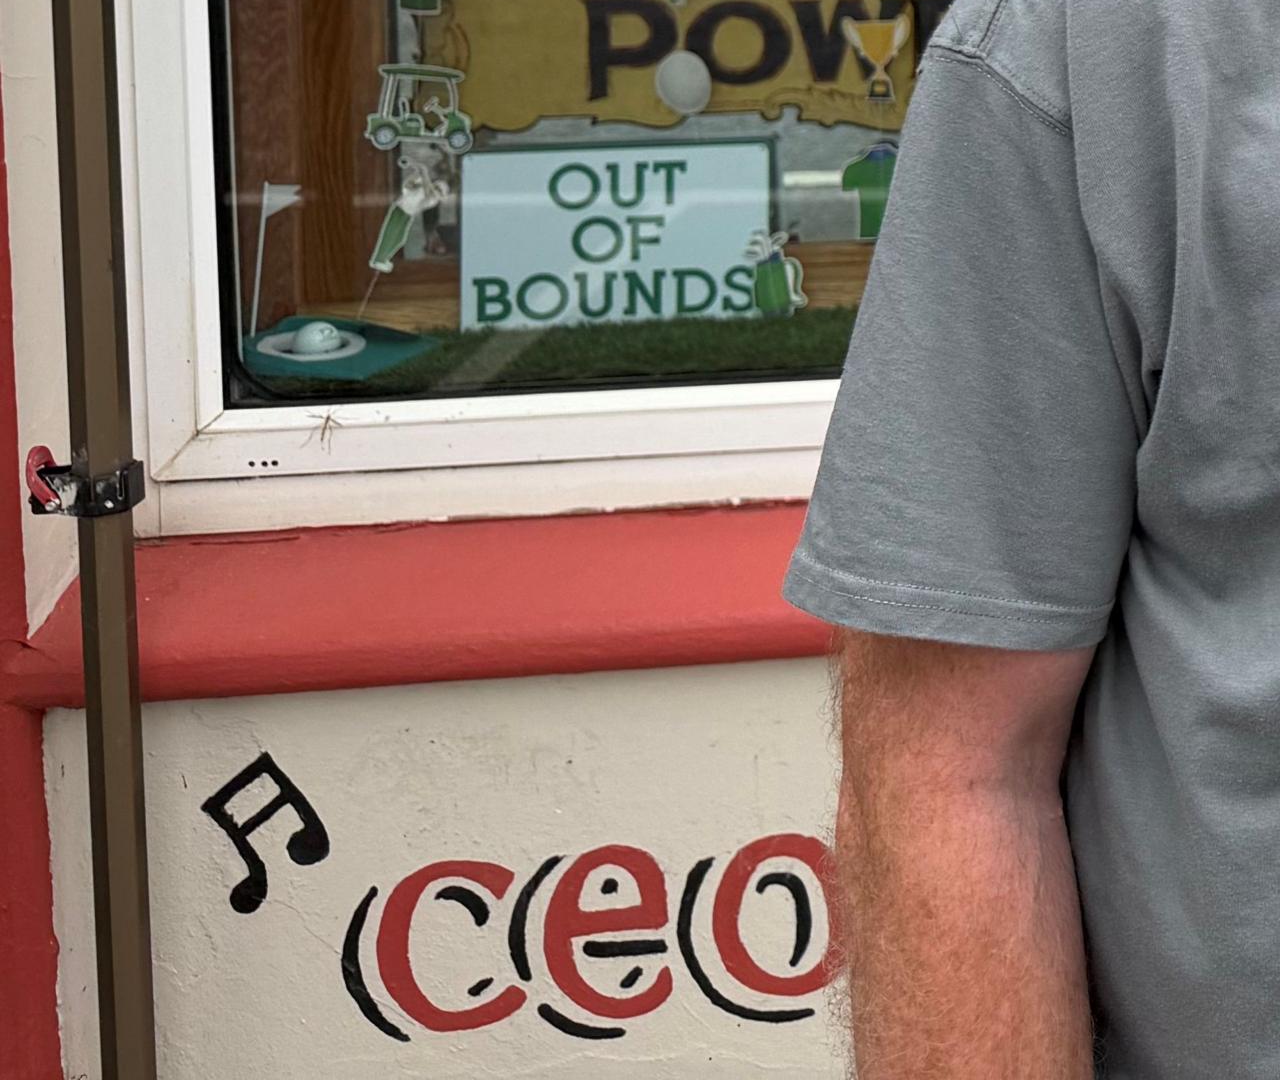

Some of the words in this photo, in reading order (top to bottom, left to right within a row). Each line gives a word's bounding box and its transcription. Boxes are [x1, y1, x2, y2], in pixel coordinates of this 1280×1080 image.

[548, 159, 688, 210] OUT
[571, 215, 666, 263] OF
[471, 265, 755, 323] BOUNDS
